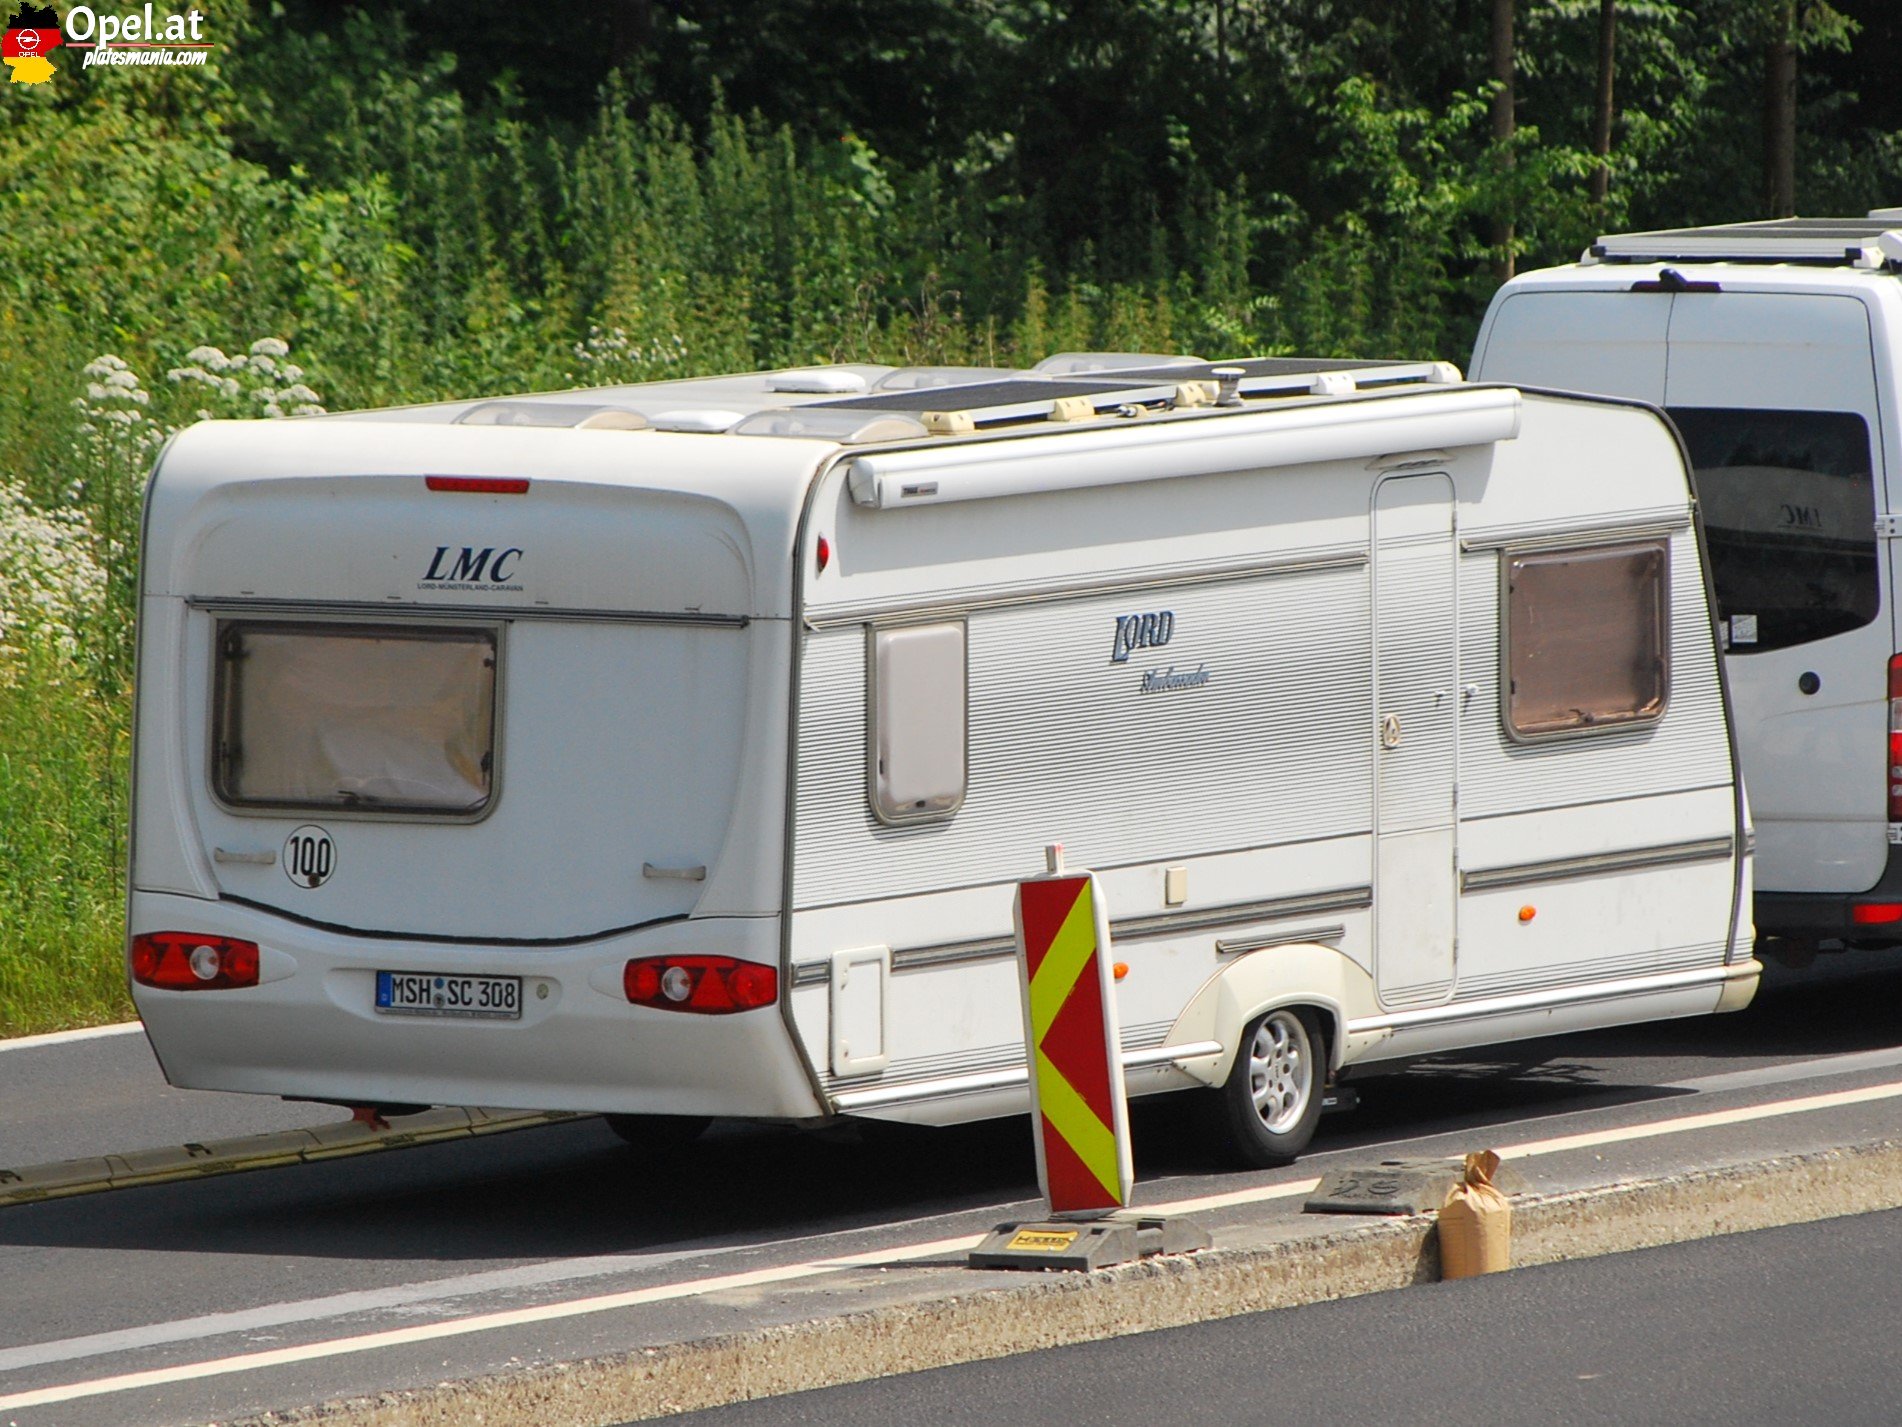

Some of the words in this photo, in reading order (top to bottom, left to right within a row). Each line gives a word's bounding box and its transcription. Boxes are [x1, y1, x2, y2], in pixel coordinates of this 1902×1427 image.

[422, 546, 525, 583] LMC
[1112, 611, 1174, 662] LORD
[290, 836, 331, 877] 100
[392, 977, 431, 1005] MSH
[447, 979, 473, 1006] SC
[478, 981, 516, 1009] 308
